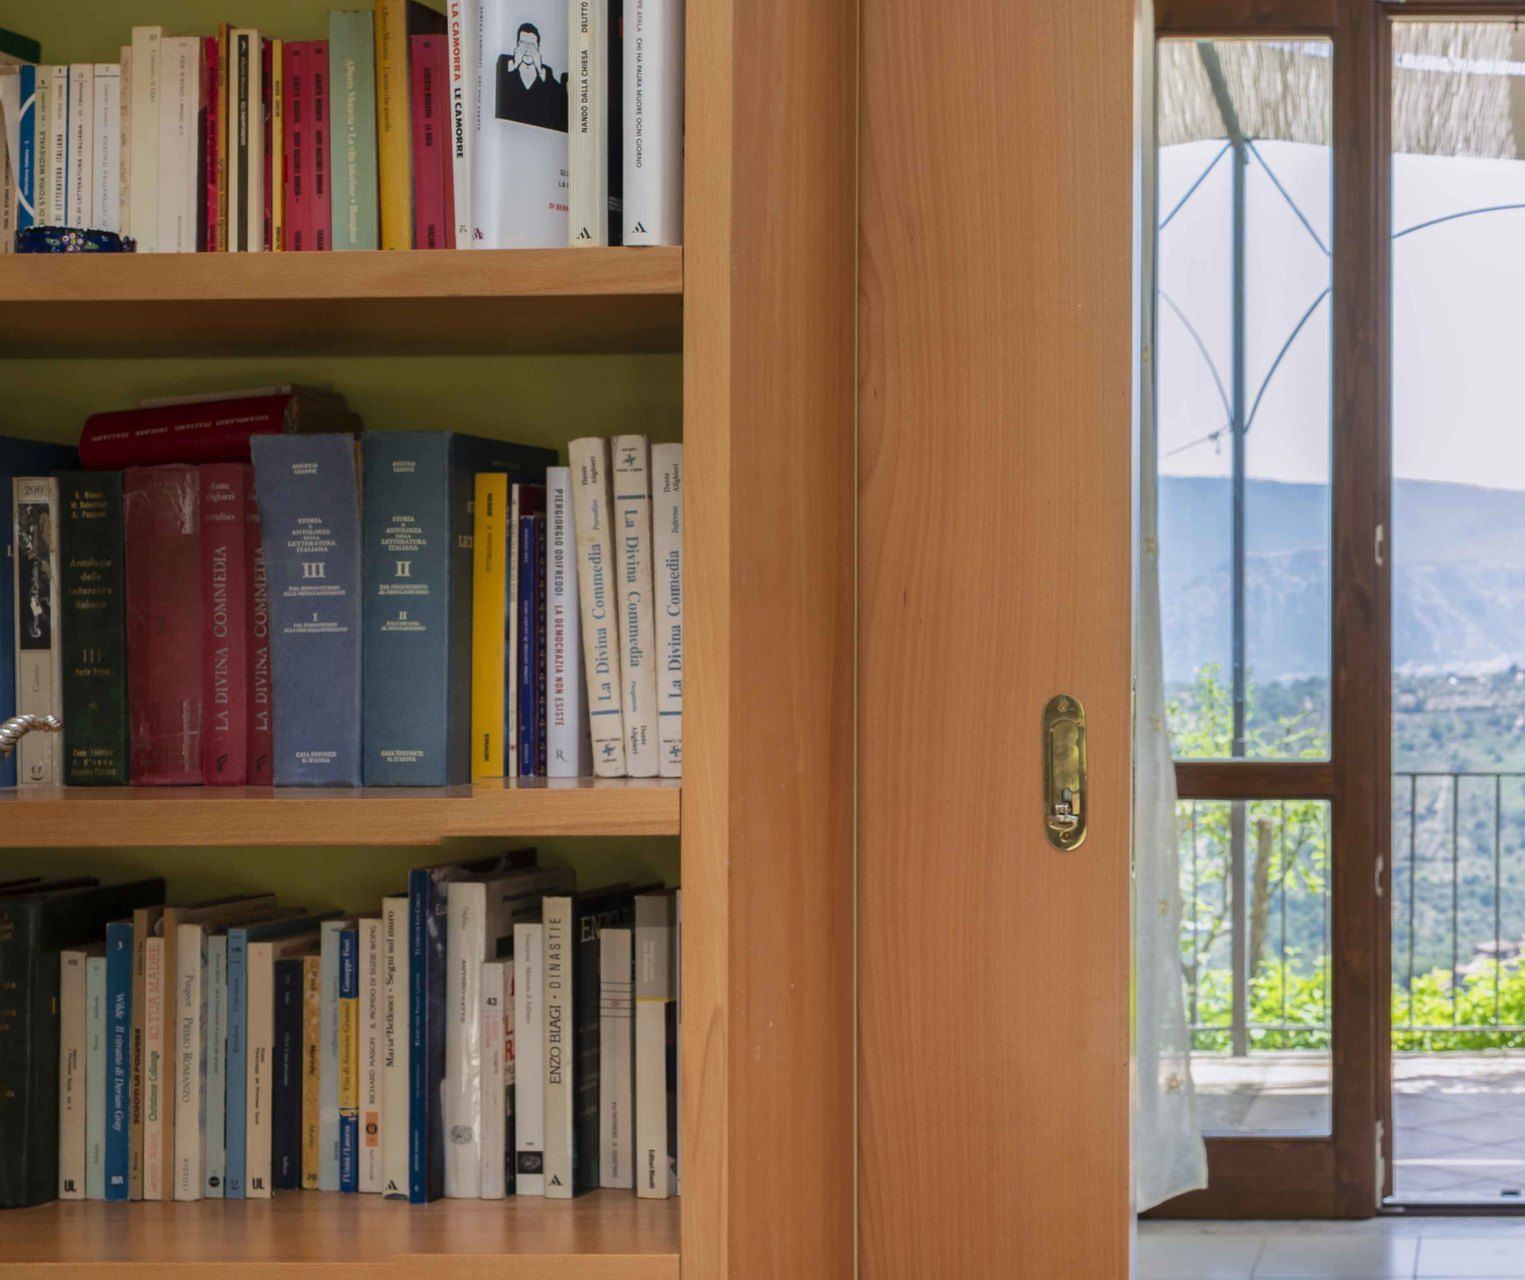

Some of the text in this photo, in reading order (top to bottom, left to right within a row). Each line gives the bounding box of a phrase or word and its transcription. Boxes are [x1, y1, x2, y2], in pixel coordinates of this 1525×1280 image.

[581, 4, 590, 34] DELITTO
[581, 49, 589, 74] CHIESA
[636, 54, 643, 64] HA
[452, 3, 464, 160] LA CAMORRA LE CAMORRE
[581, 74, 589, 101] DALLA
[581, 103, 589, 134] NANDO
[301, 561, 326, 579] III
[554, 488, 564, 728] PIERGIORGIO ODIFREDDI LA DEMOCRAZIA NON ESISTE
[591, 543, 612, 701] La Divina Commedia
[213, 545, 229, 733] LA DIVINA COMMEDIA
[385, 910, 395, 1068] Maria Bellonci Segni sul muro
[550, 916, 562, 1085] ENZO BIAGI DINASTIE
[115, 993, 125, 1019] Wilde
[115, 1036, 124, 1064] ritratto
[182, 1016, 193, 1104] PRIMO ROMANZO
[114, 1065, 123, 1075] di
[113, 1076, 124, 1111] Dorian
[112, 1110, 123, 1133] Gray
